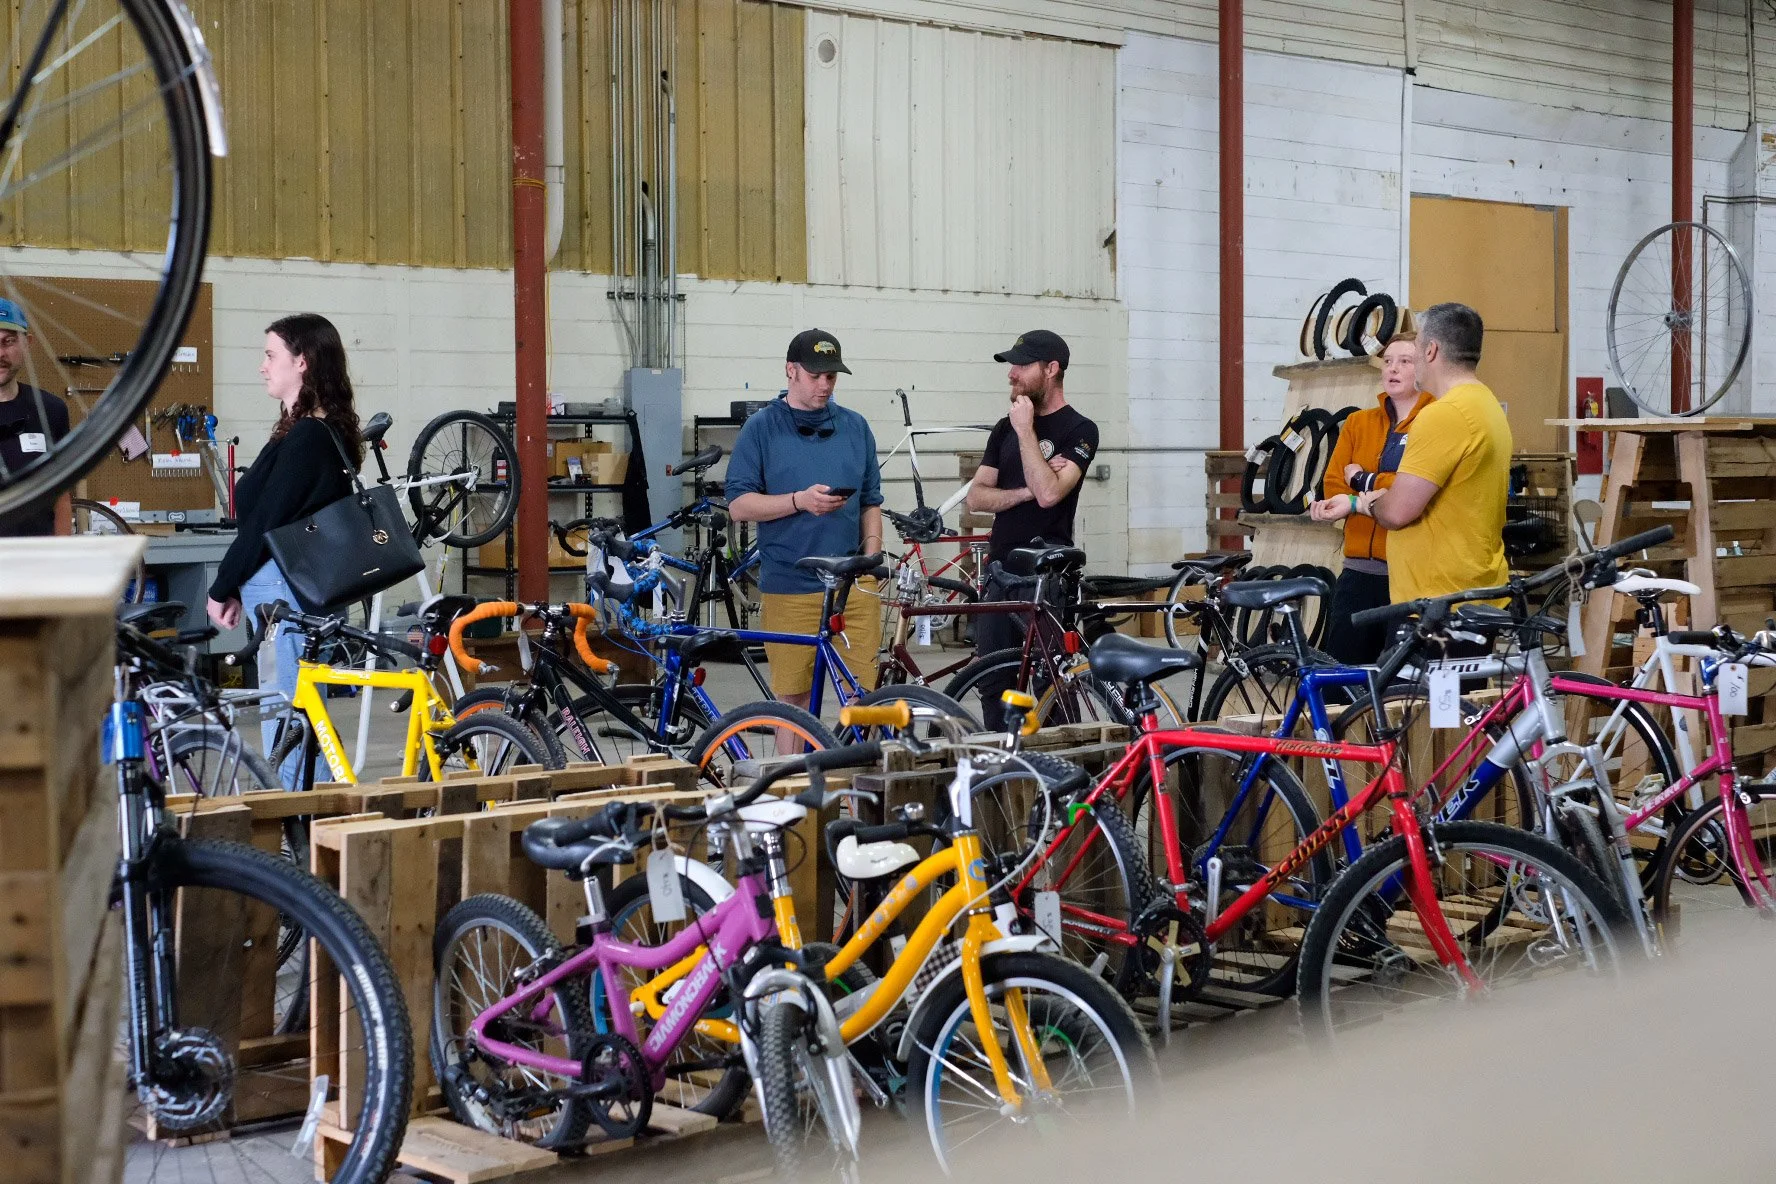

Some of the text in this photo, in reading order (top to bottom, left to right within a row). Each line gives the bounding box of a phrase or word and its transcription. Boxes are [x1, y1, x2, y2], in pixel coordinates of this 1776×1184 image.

[562, 706, 591, 755] RALEIGH
[1266, 806, 1350, 886] SCHWINN
[649, 943, 727, 1053] DIAMONDBACK
